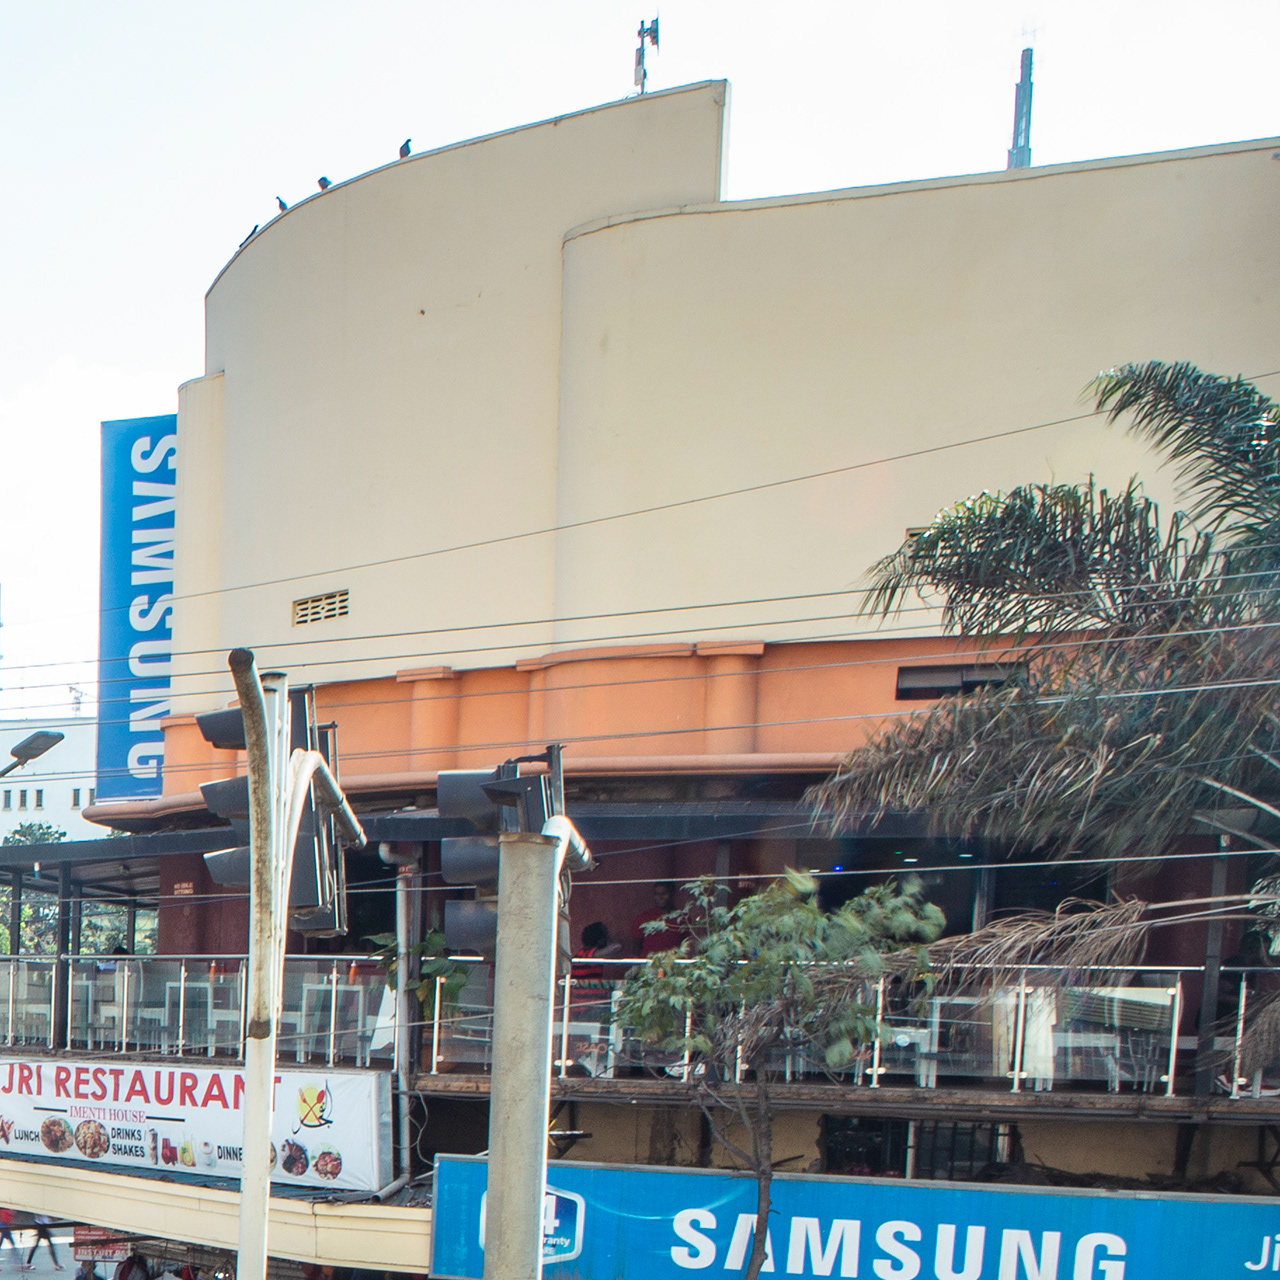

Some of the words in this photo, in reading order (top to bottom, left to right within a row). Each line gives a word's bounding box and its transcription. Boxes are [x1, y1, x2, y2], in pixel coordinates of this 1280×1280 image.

[69, 1105, 106, 1120] IMENTI
[108, 1108, 147, 1123] HOUSE
[14, 1129, 40, 1142] LUNCH
[111, 1127, 142, 1142] DRINKS
[111, 1143, 145, 1158] SHAKES
[217, 1145, 243, 1161] DINNE
[543, 1237, 571, 1248] ranty
